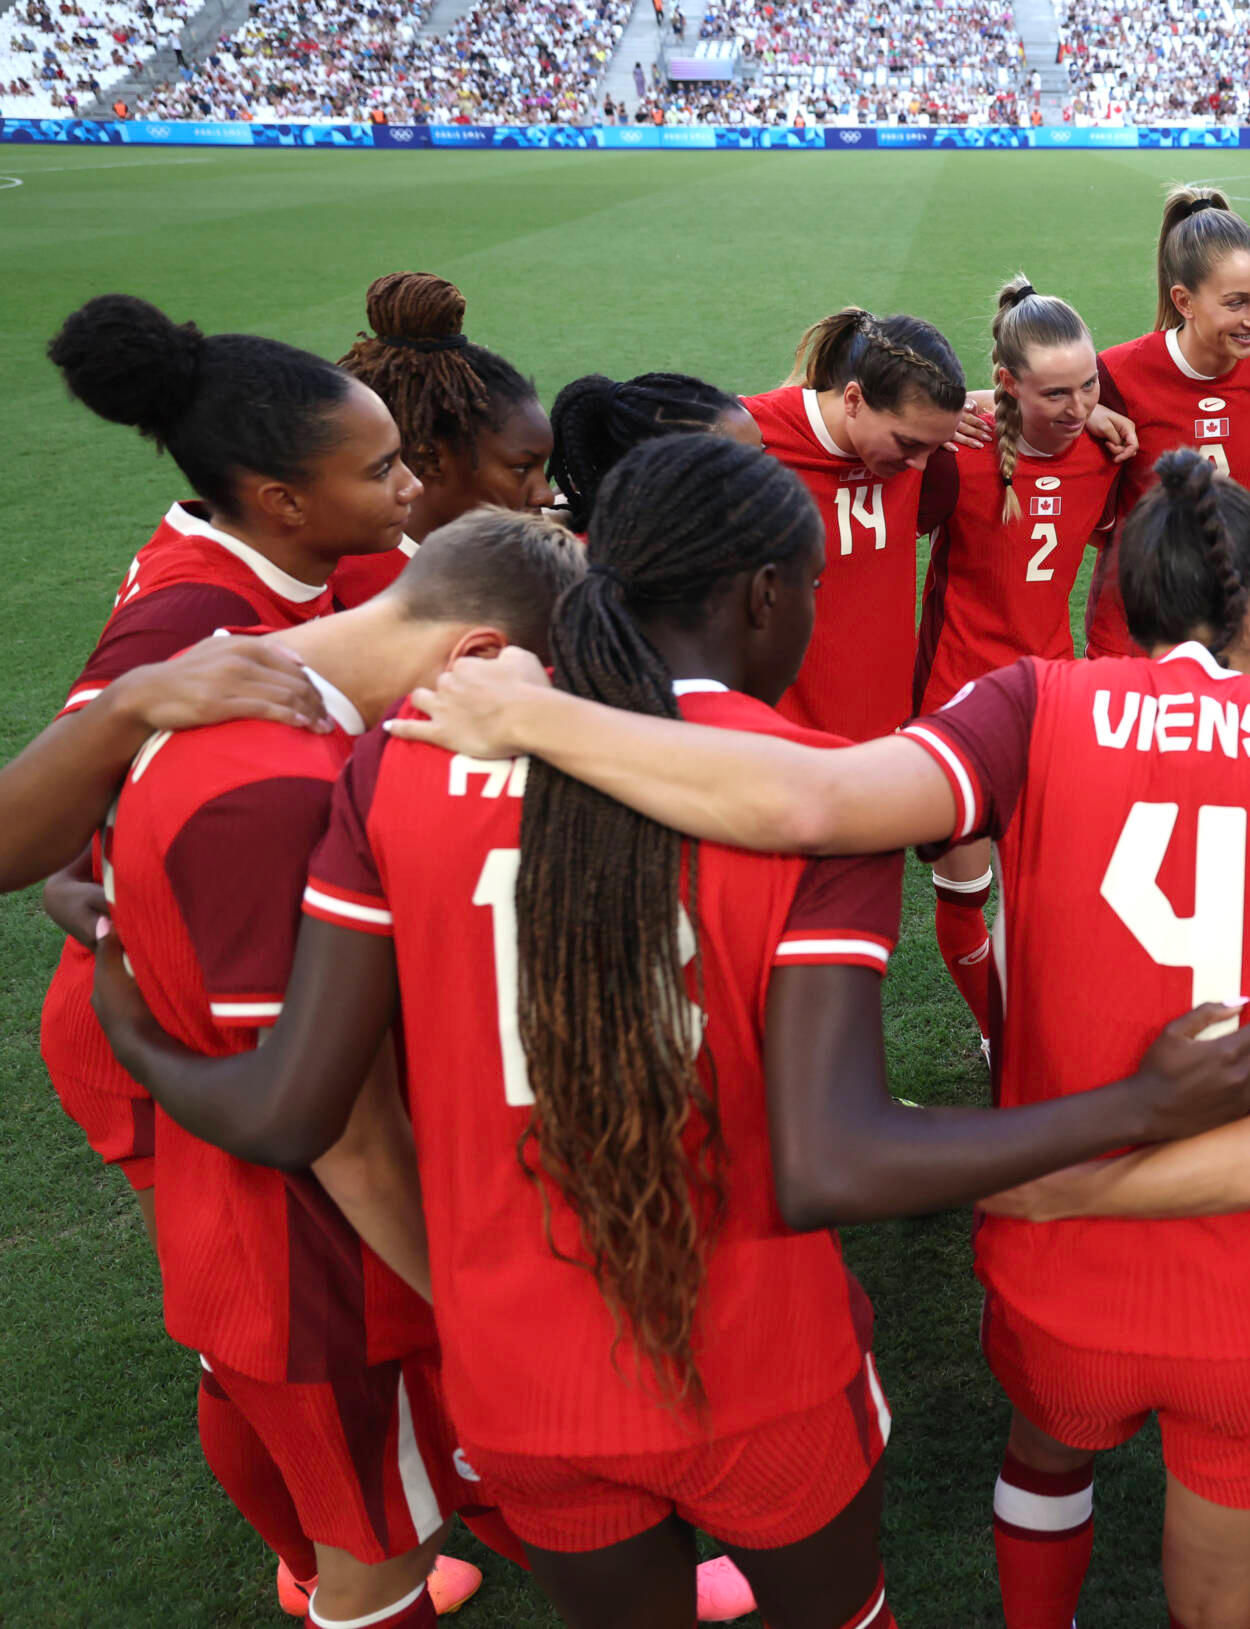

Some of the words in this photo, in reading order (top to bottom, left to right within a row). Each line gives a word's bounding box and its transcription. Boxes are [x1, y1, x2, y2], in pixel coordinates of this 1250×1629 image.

[834, 483, 887, 556] 14
[1025, 522, 1059, 582] 2
[1100, 801, 1247, 1042] 4
